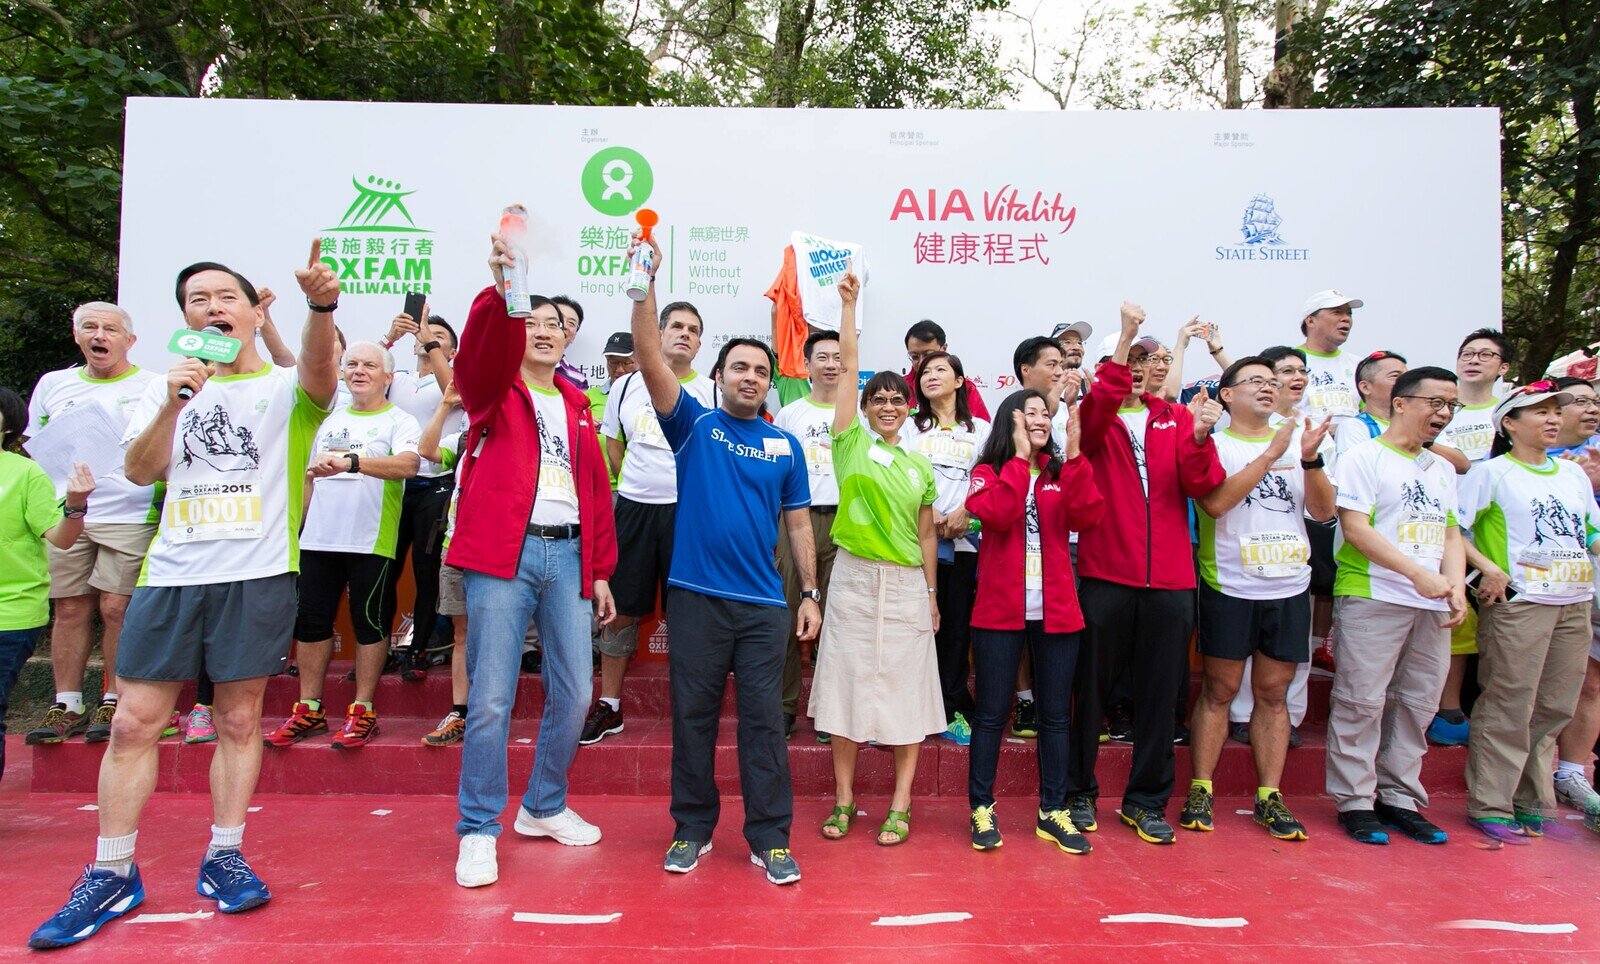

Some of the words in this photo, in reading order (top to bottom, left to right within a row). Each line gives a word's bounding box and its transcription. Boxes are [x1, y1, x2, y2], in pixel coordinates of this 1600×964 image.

[580, 136, 609, 144] Organiser
[889, 188, 975, 221] AIA
[983, 183, 1077, 235] Vitality
[579, 225, 631, 250] 樂施
[689, 226, 750, 243] 無窮世界
[689, 249, 727, 262] World
[913, 231, 1050, 266] 健康程式
[1215, 246, 1256, 261] STATE
[1259, 246, 1310, 261] STREET
[689, 266, 741, 279] Without
[580, 281, 614, 297] Hong
[689, 282, 739, 297] Poverty
[203, 344, 231, 354] OXFAM
[222, 484, 252, 493] 2015
[174, 499, 253, 527] L0001
